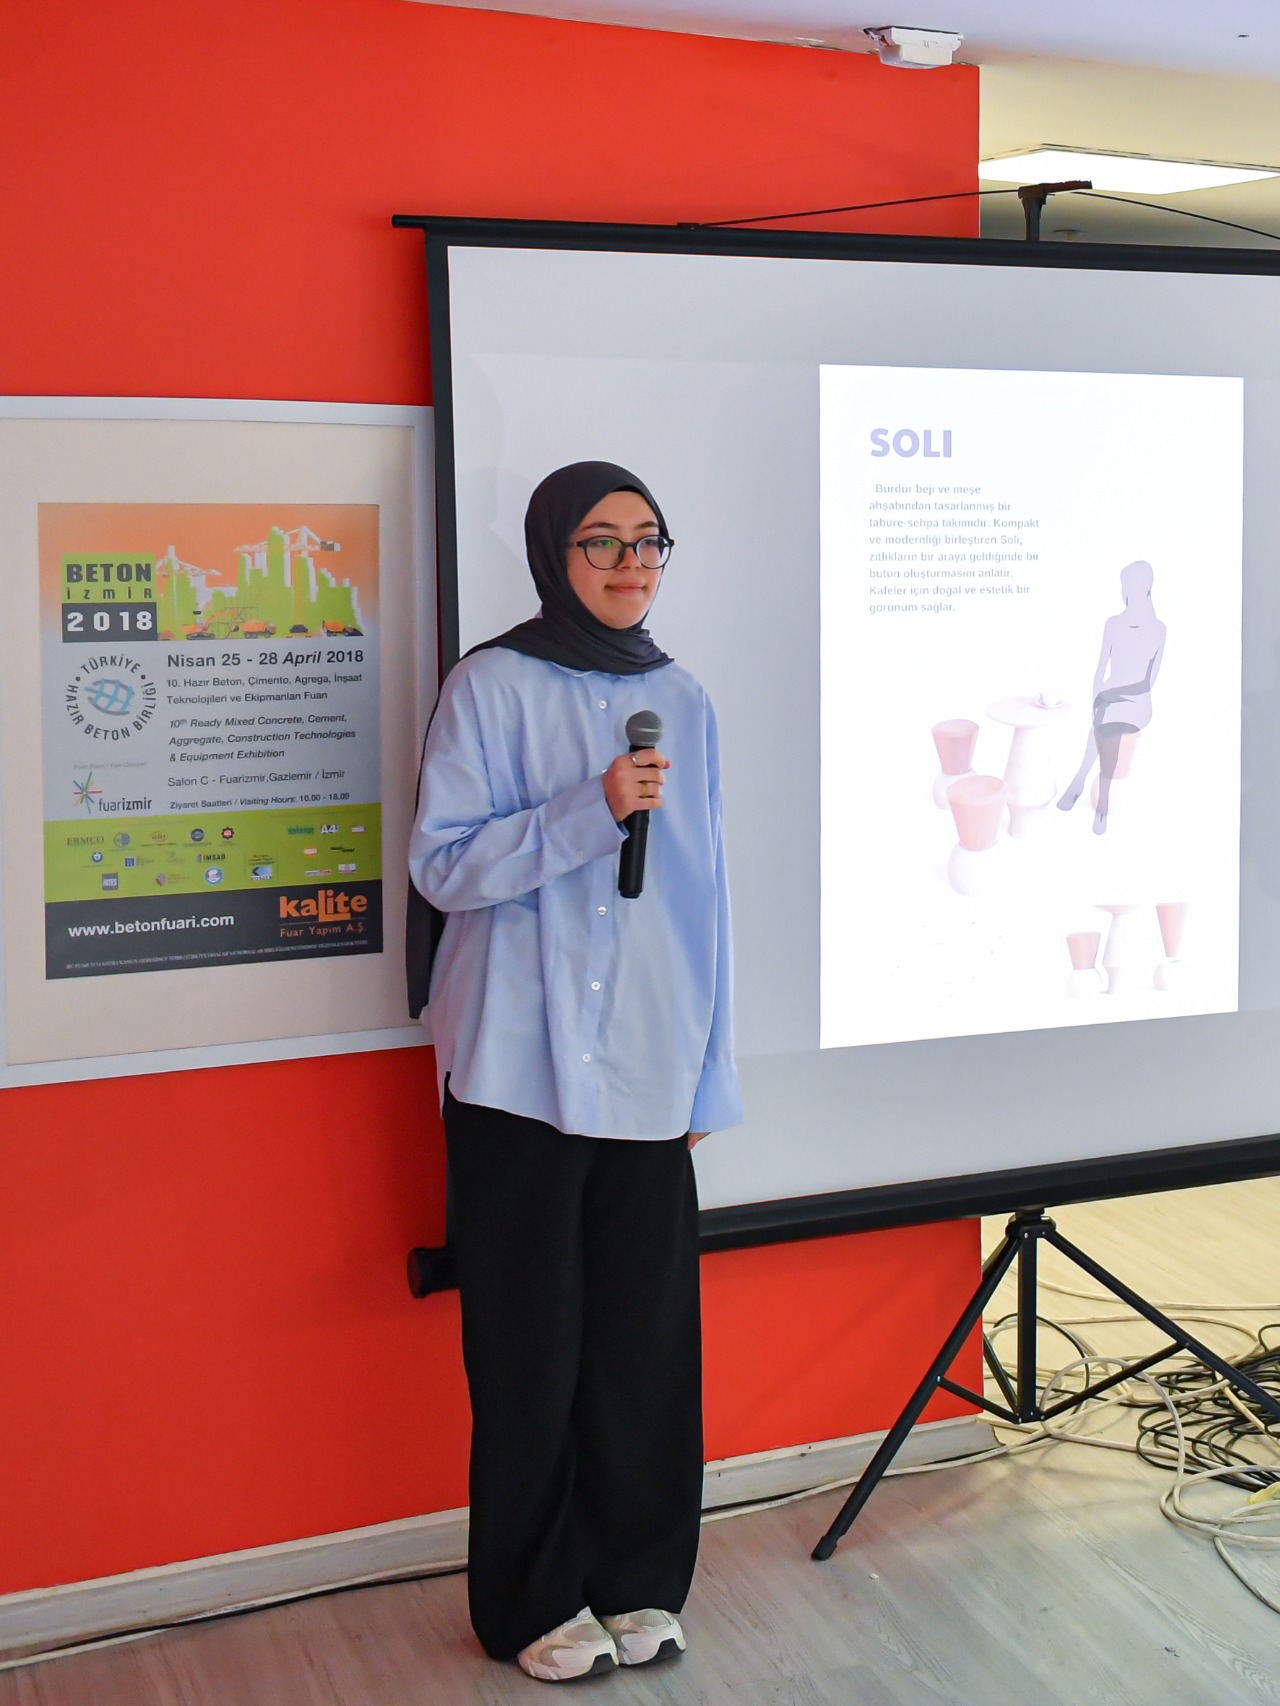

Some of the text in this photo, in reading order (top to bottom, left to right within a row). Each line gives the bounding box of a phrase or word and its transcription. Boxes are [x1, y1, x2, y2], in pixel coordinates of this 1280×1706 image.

[870, 428, 952, 458] SOLI
[875, 484, 981, 496] Burdur beji ve meşe
[869, 501, 1011, 512] ahşabından tasarlanmış bir
[869, 518, 1039, 530] tabure-sehpa takımıdır. Kompakt
[869, 535, 1023, 546] ve modernliği birleştiren Soli,
[869, 552, 1039, 563] zıtlıkların bir araya geldiğinde bir
[66, 563, 152, 583] BETON
[904, 569, 976, 580] oluşturmasını
[978, 568, 1013, 578] anlatır.
[869, 585, 1030, 597] Kafeler için doğal ve estetik bir
[921, 602, 956, 614] sağlar.
[67, 611, 153, 632] 2018
[80, 653, 141, 675] TÜRKİYE
[167, 654, 216, 668] Nisan
[221, 653, 241, 666] 25
[259, 652, 278, 665] 28
[282, 650, 322, 667] April
[326, 650, 364, 663] 2018
[167, 672, 363, 688] 10. Hazır Beton, Çimento, Agrega, İnşaat
[167, 694, 227, 705] Teknolojileri
[230, 695, 242, 703] ve
[66, 681, 157, 741] HAZIR BETON BİRLİĞİ
[190, 718, 222, 729] Ready
[225, 717, 255, 727] Mixed
[257, 715, 304, 726] Concrete,
[307, 714, 347, 723] Cement,
[169, 730, 357, 748] Aggregate, Construction Technologies
[169, 750, 285, 763] & Equipment Exhibition
[168, 777, 197, 787] Salon
[200, 776, 209, 786] C
[322, 768, 346, 779] İzmir
[98, 797, 153, 812] fuarizmir
[170, 801, 199, 810] Ziyaret
[240, 798, 269, 806] Visiting
[300, 794, 321, 802] 10.00
[328, 792, 350, 800] 18.00
[67, 835, 104, 846] ERMCO
[68, 915, 235, 938] www.betonfuari.com
[280, 928, 305, 938] Fuar
[309, 926, 342, 937] Yapım
